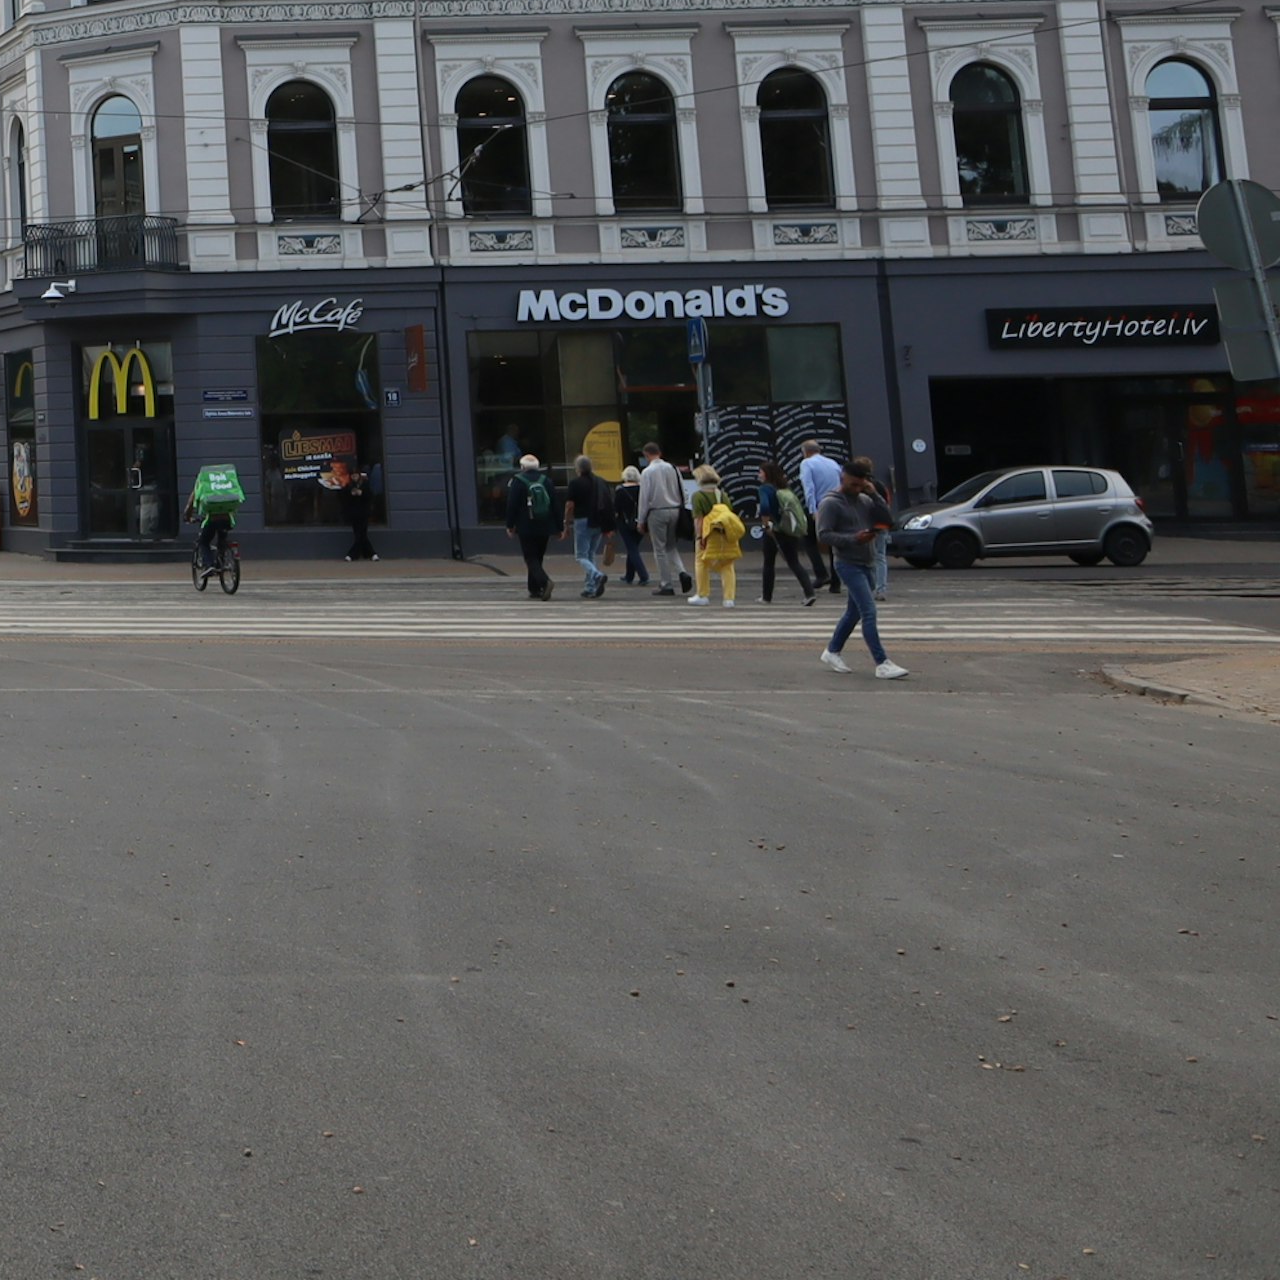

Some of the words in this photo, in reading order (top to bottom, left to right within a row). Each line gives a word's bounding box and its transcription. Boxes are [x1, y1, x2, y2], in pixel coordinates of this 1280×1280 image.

[268, 297, 364, 338] McCafé
[517, 284, 790, 322] McDonald's
[387, 392, 398, 401] 18
